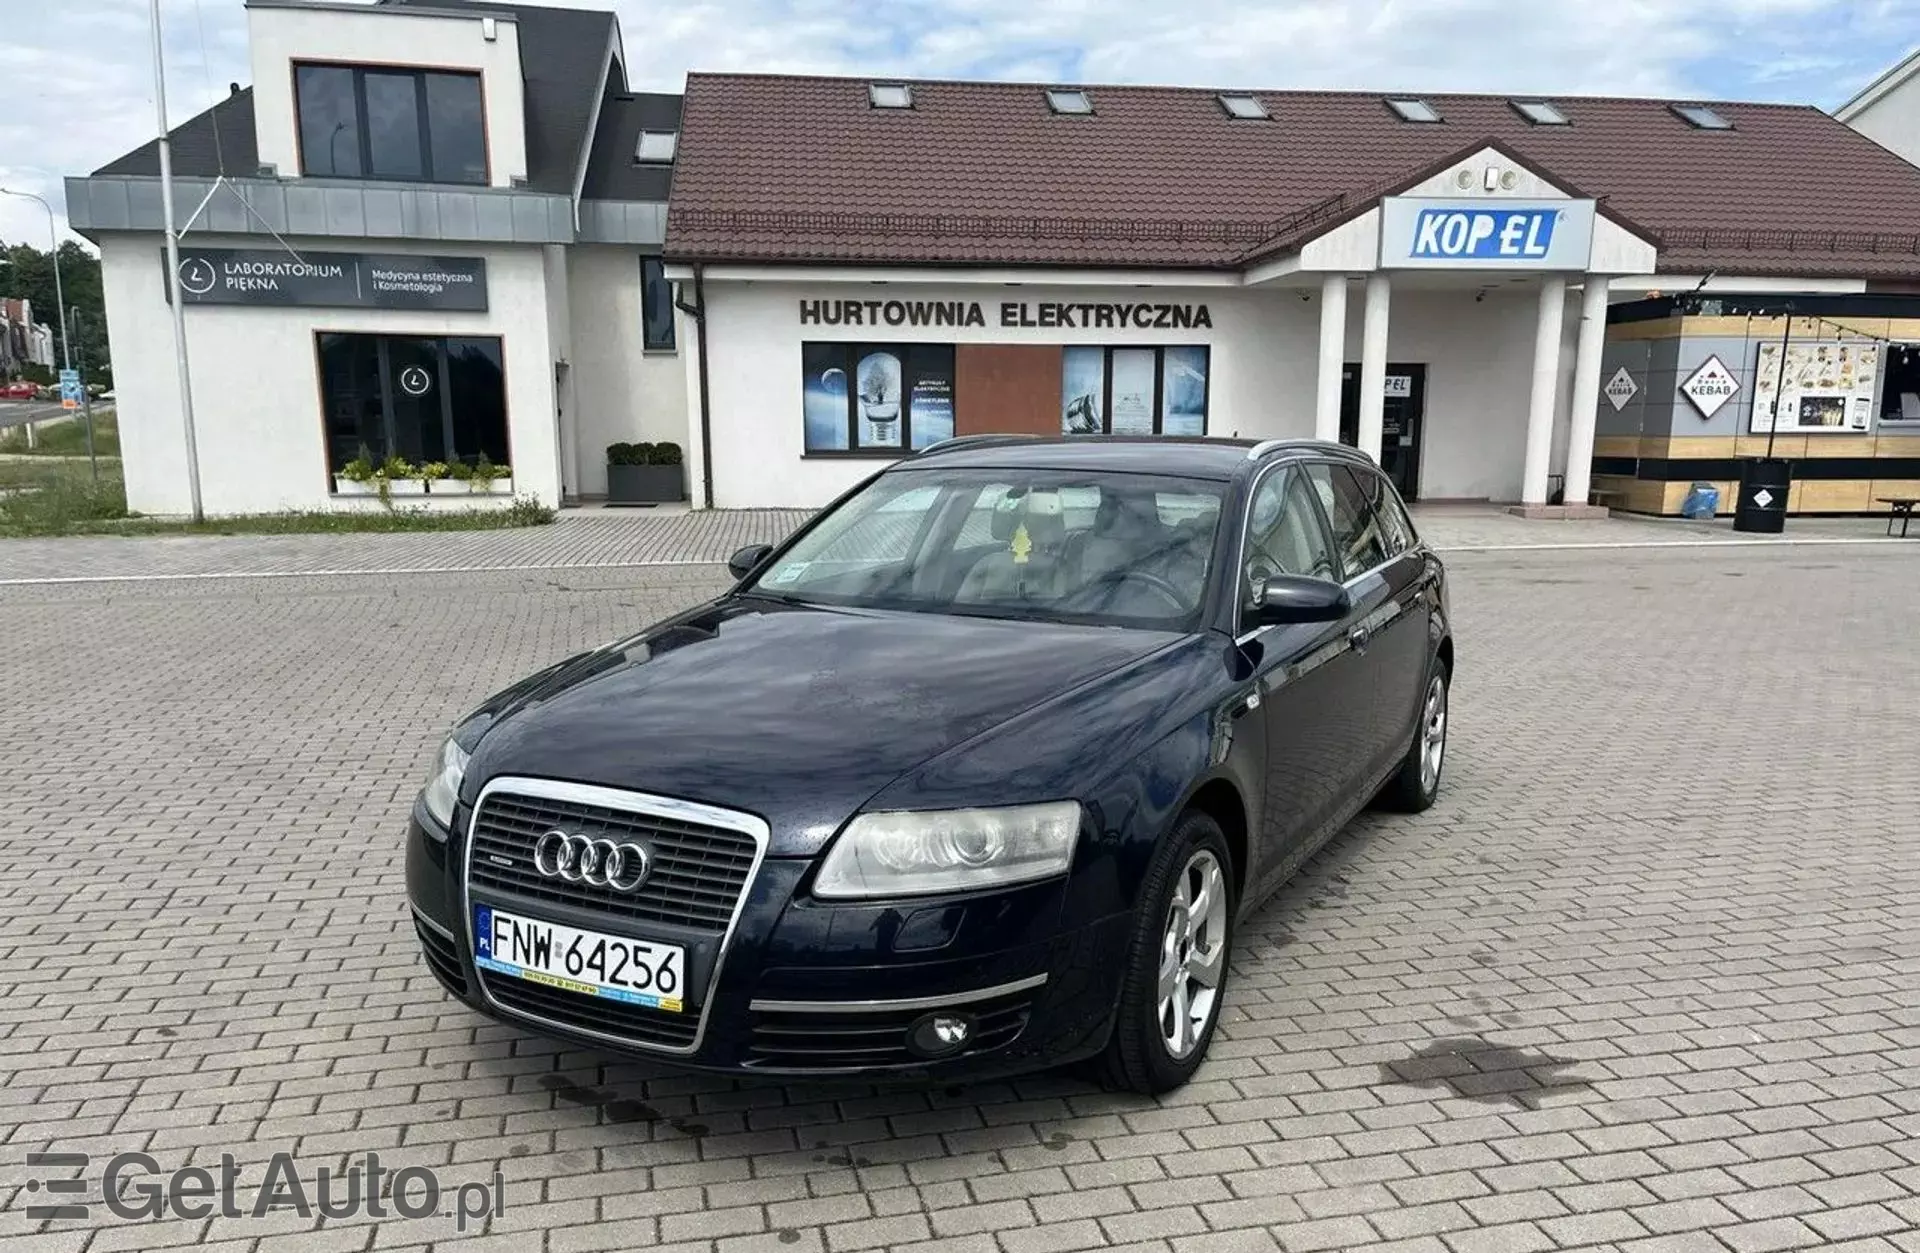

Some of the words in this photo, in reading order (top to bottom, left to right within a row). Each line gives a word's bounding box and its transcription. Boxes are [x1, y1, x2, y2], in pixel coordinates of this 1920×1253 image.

[224, 262, 343, 278] LABORATORIUM
[372, 270, 420, 282] Medycyna
[422, 273, 473, 284] estetyczna
[226, 278, 279, 291] PIĘKNA
[379, 281, 443, 294] Kosmetologia
[800, 300, 985, 327] HURTOWNIA
[1000, 302, 1213, 329] ELEKTRYCZNA
[1691, 385, 1731, 396] KEBAB
[493, 915, 552, 969] FNW
[565, 934, 677, 994] 64256
